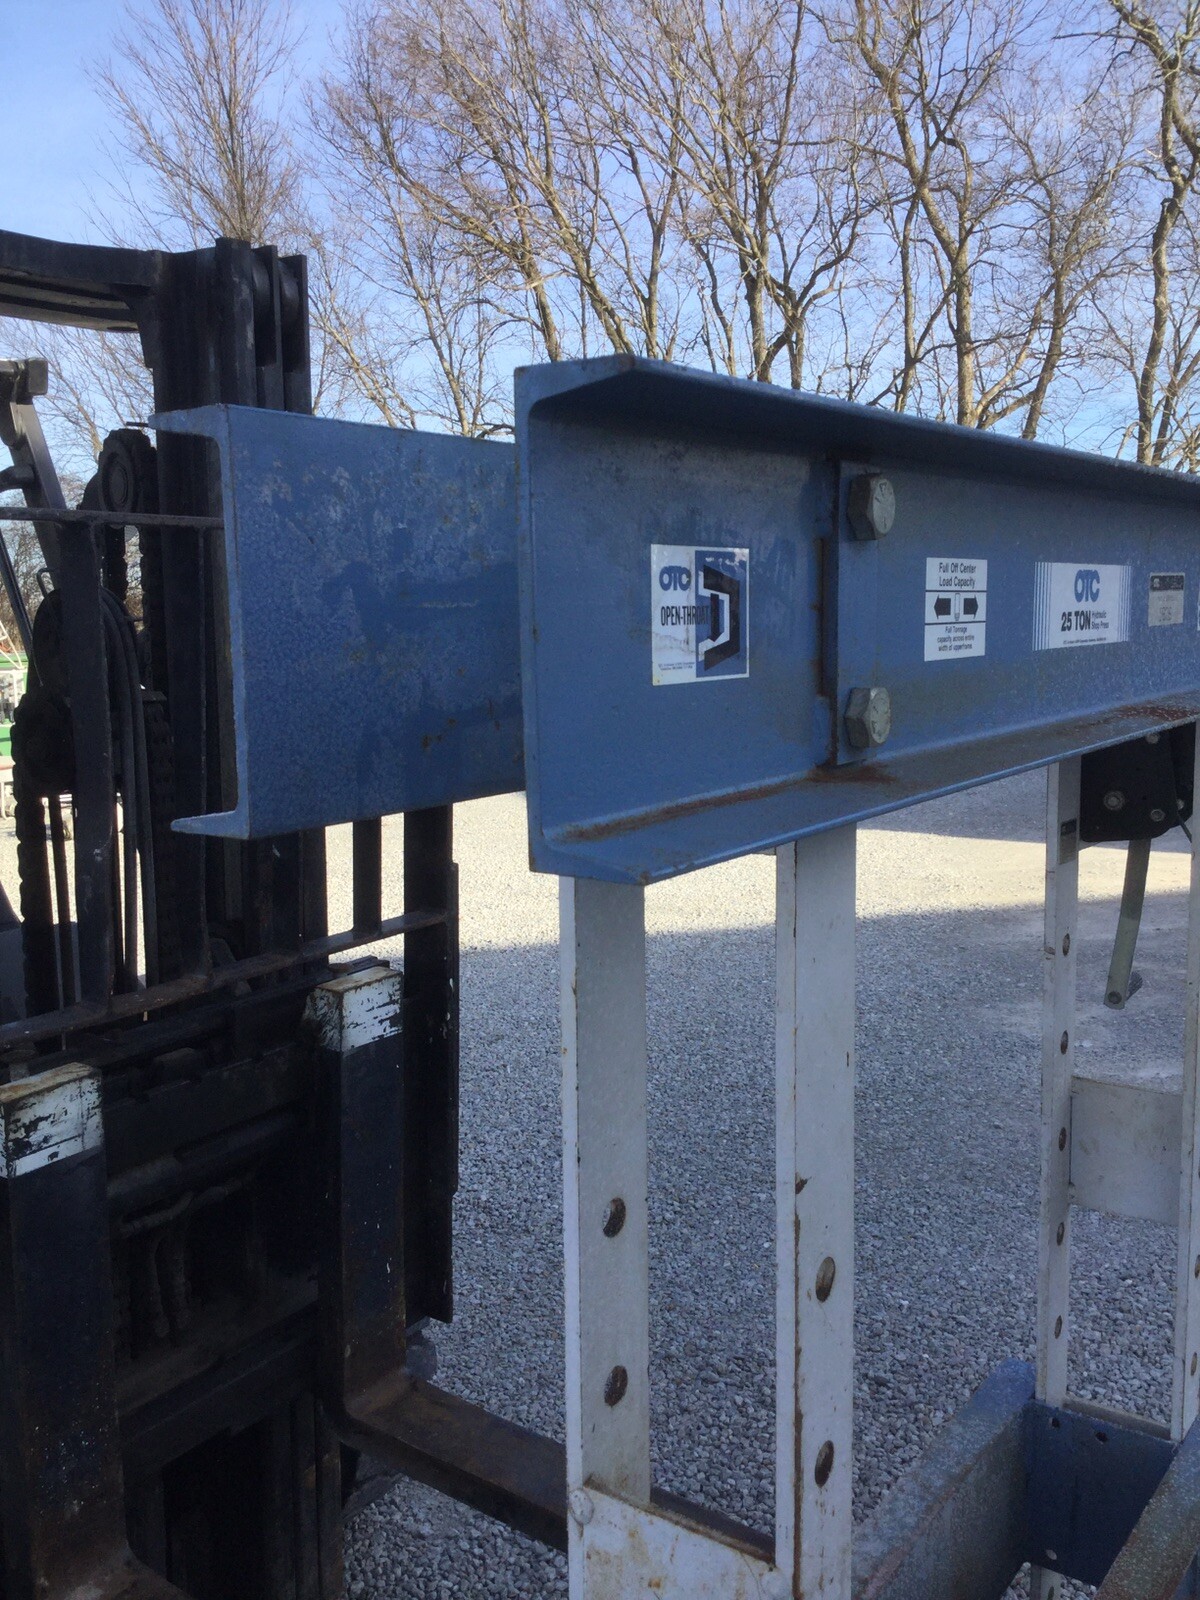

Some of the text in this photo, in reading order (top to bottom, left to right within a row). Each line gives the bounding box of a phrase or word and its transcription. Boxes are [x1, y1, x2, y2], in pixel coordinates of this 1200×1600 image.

[939, 562, 949, 573] Full
[960, 563, 976, 573] Center
[659, 566, 691, 591] OTC
[939, 576, 976, 589] Load Capacity
[1074, 569, 1100, 602] OTC
[1061, 611, 1072, 631] 25
[1074, 610, 1091, 631] TON
